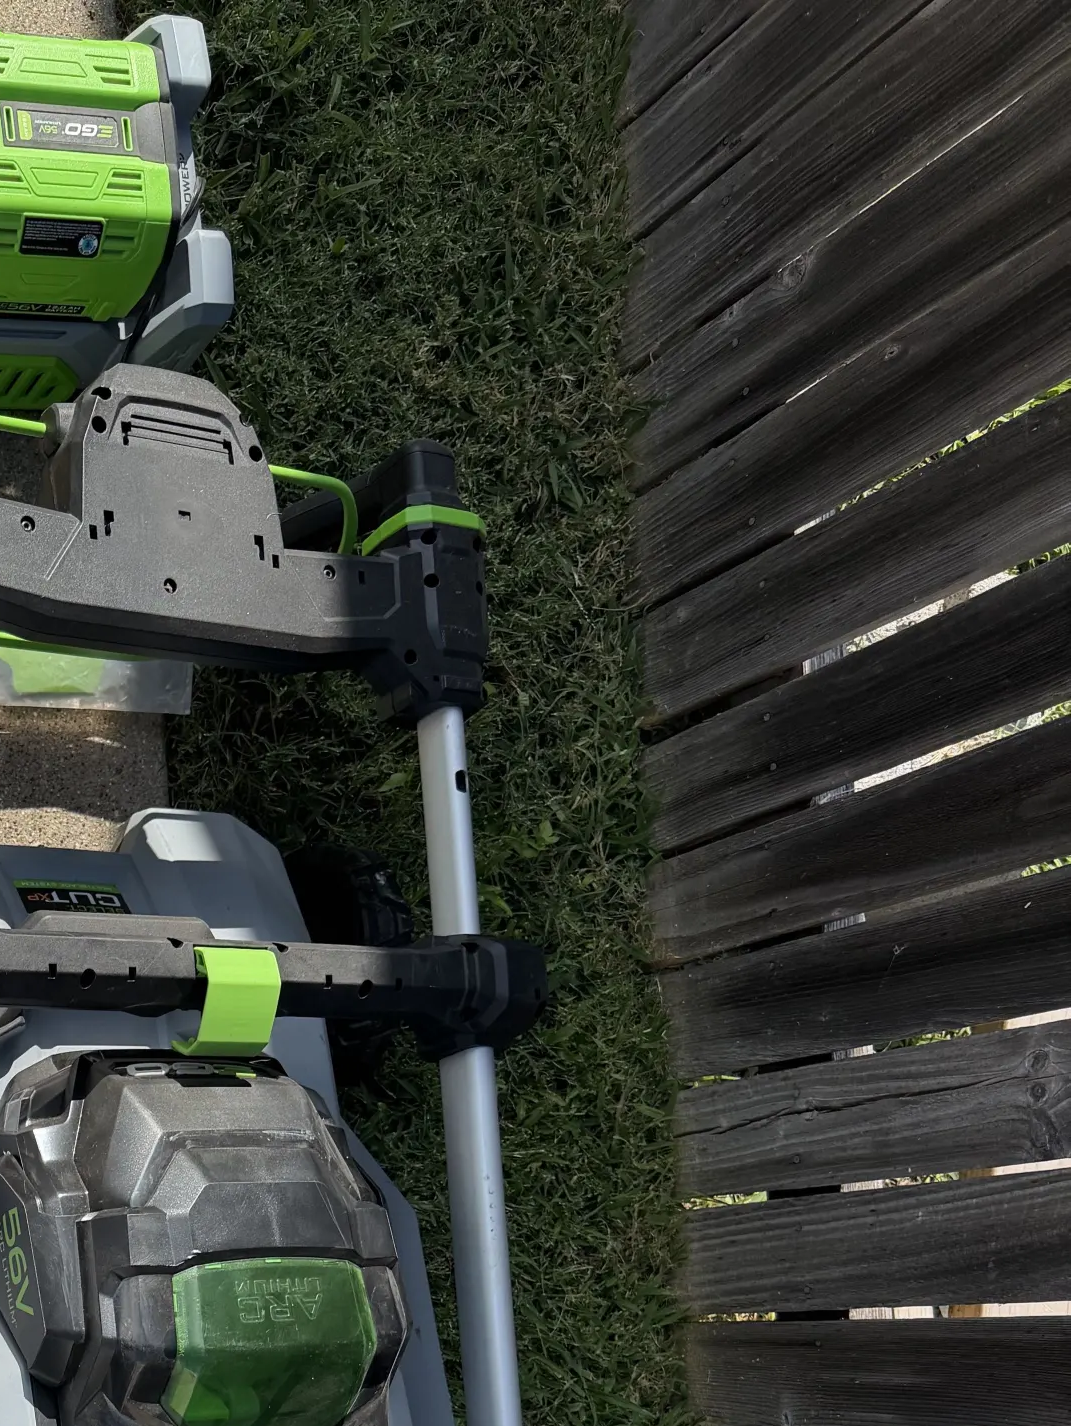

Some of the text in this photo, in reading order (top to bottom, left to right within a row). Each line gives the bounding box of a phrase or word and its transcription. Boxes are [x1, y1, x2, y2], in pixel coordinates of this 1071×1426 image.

[39, 124, 58, 134] 56V
[64, 123, 114, 138] EGO
[7, 302, 43, 311] 56V
[27, 891, 121, 907] CUT XP
[2, 1206, 34, 1316] 56V
[1, 1257, 17, 1324] LITHIUM
[234, 1278, 320, 1295] LITHIUM
[237, 1293, 323, 1323] ARC
